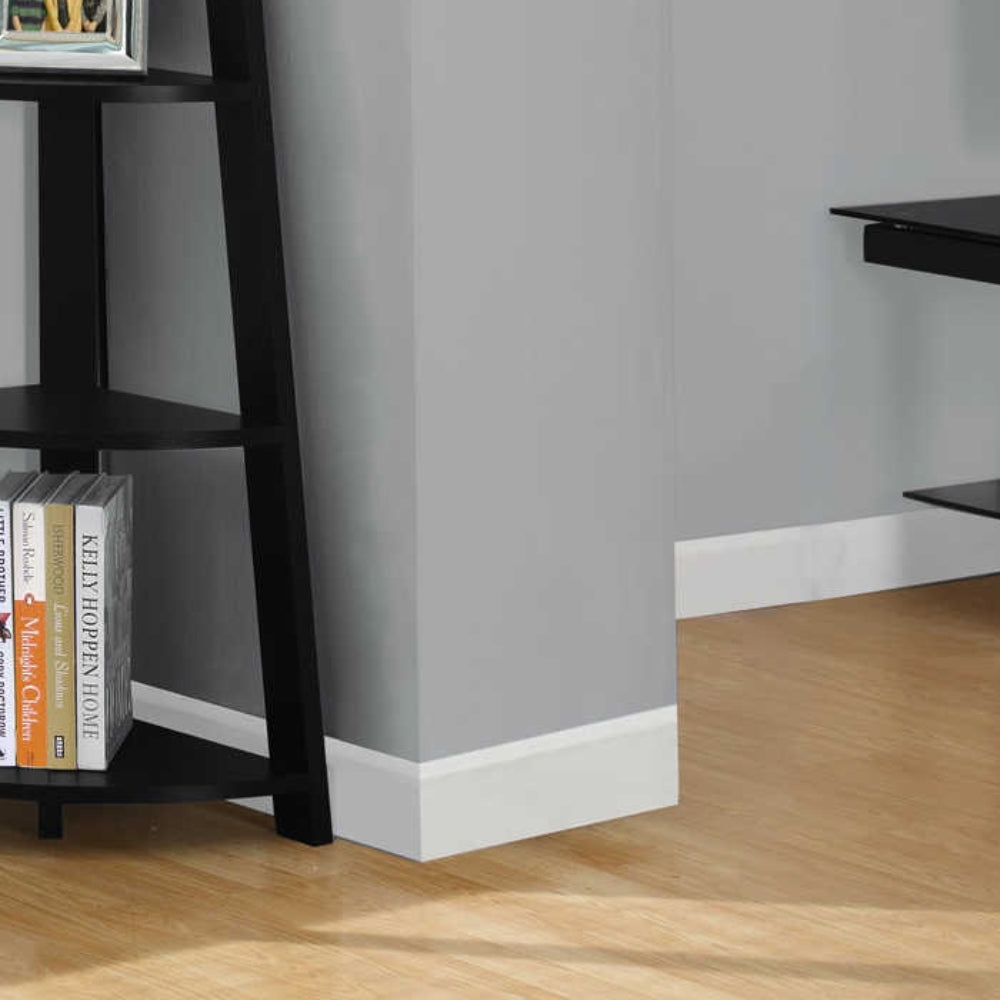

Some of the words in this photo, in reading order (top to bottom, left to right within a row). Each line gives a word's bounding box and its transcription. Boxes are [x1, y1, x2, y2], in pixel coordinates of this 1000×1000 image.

[52, 524, 65, 594] ISHERWOOD
[82, 534, 98, 591] KELLY
[20, 616, 40, 682] Midnight's
[82, 597, 99, 677] HOPPEN
[22, 684, 41, 741] Children
[82, 683, 99, 740] HOME
